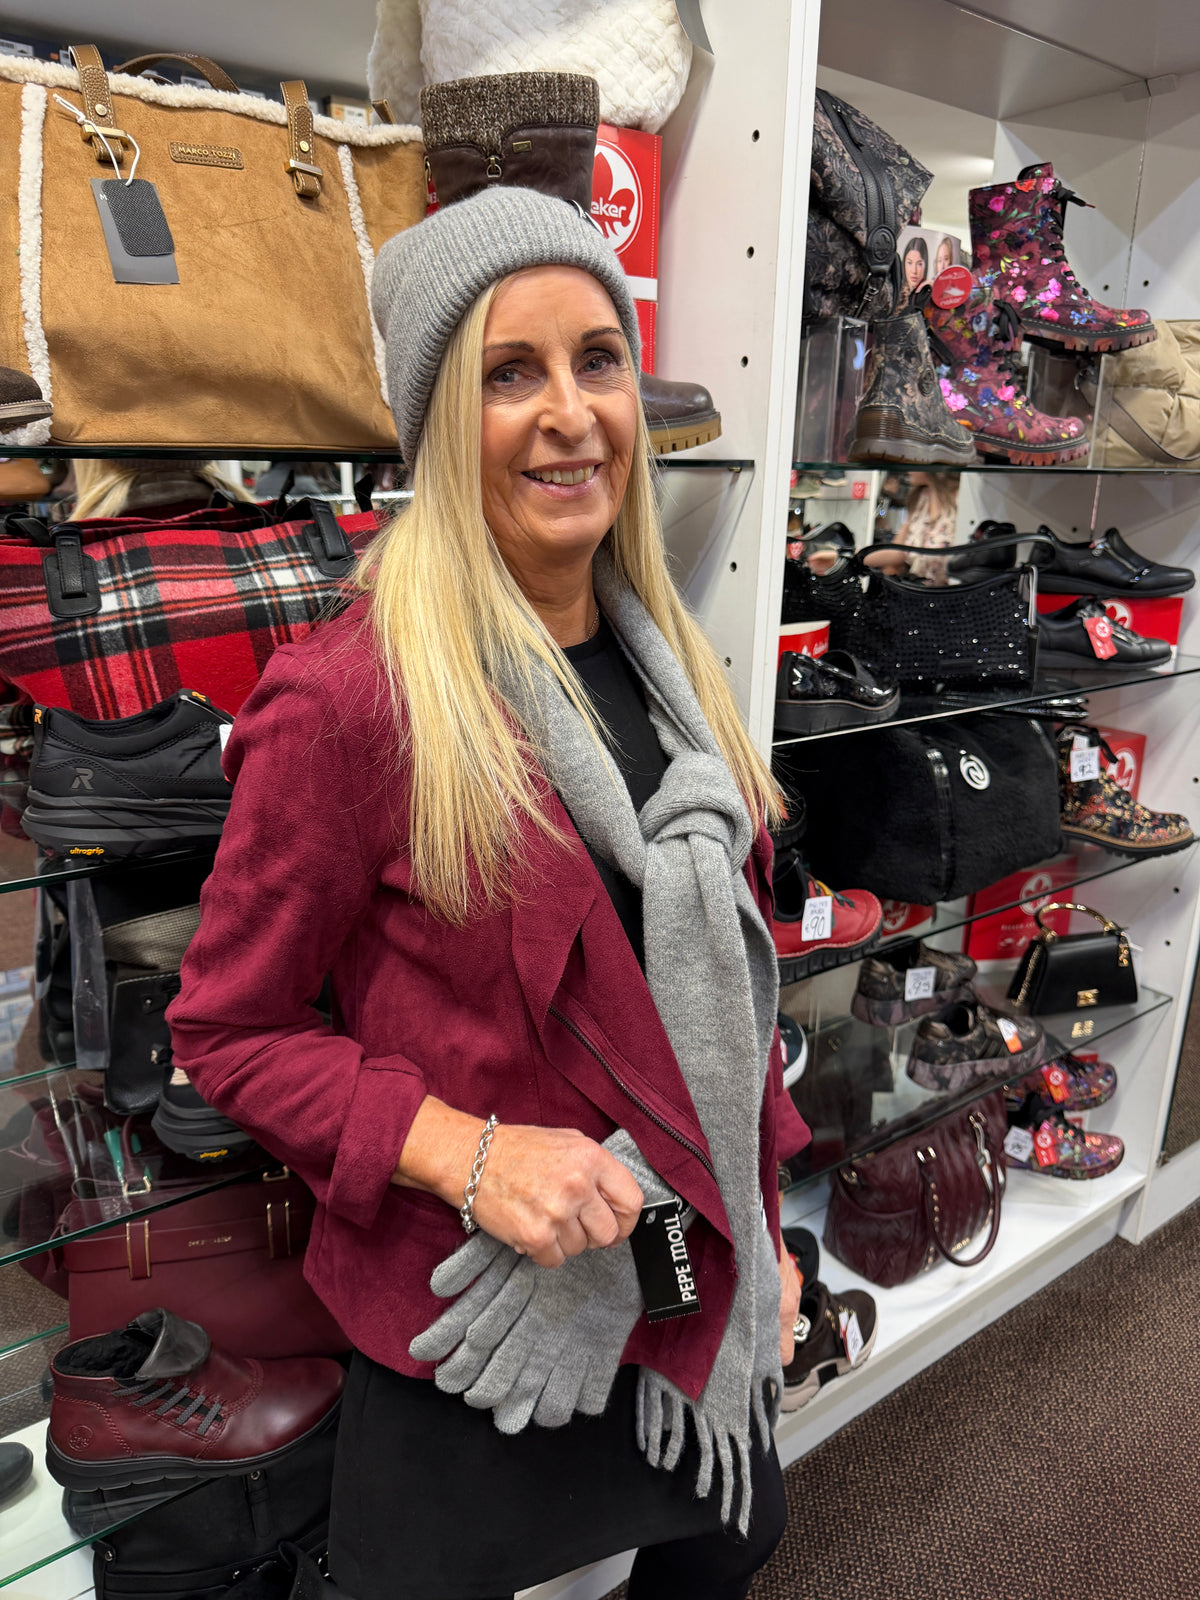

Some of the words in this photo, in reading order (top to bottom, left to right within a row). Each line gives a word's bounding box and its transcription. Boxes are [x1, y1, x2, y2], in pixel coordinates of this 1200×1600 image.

[178, 146, 209, 156] MARCO
[211, 149, 236, 161] TOZZI
[590, 196, 627, 219] eker
[70, 767, 95, 790] R
[664, 1213, 688, 1262] MOLL
[675, 1264, 697, 1302] PEPE
